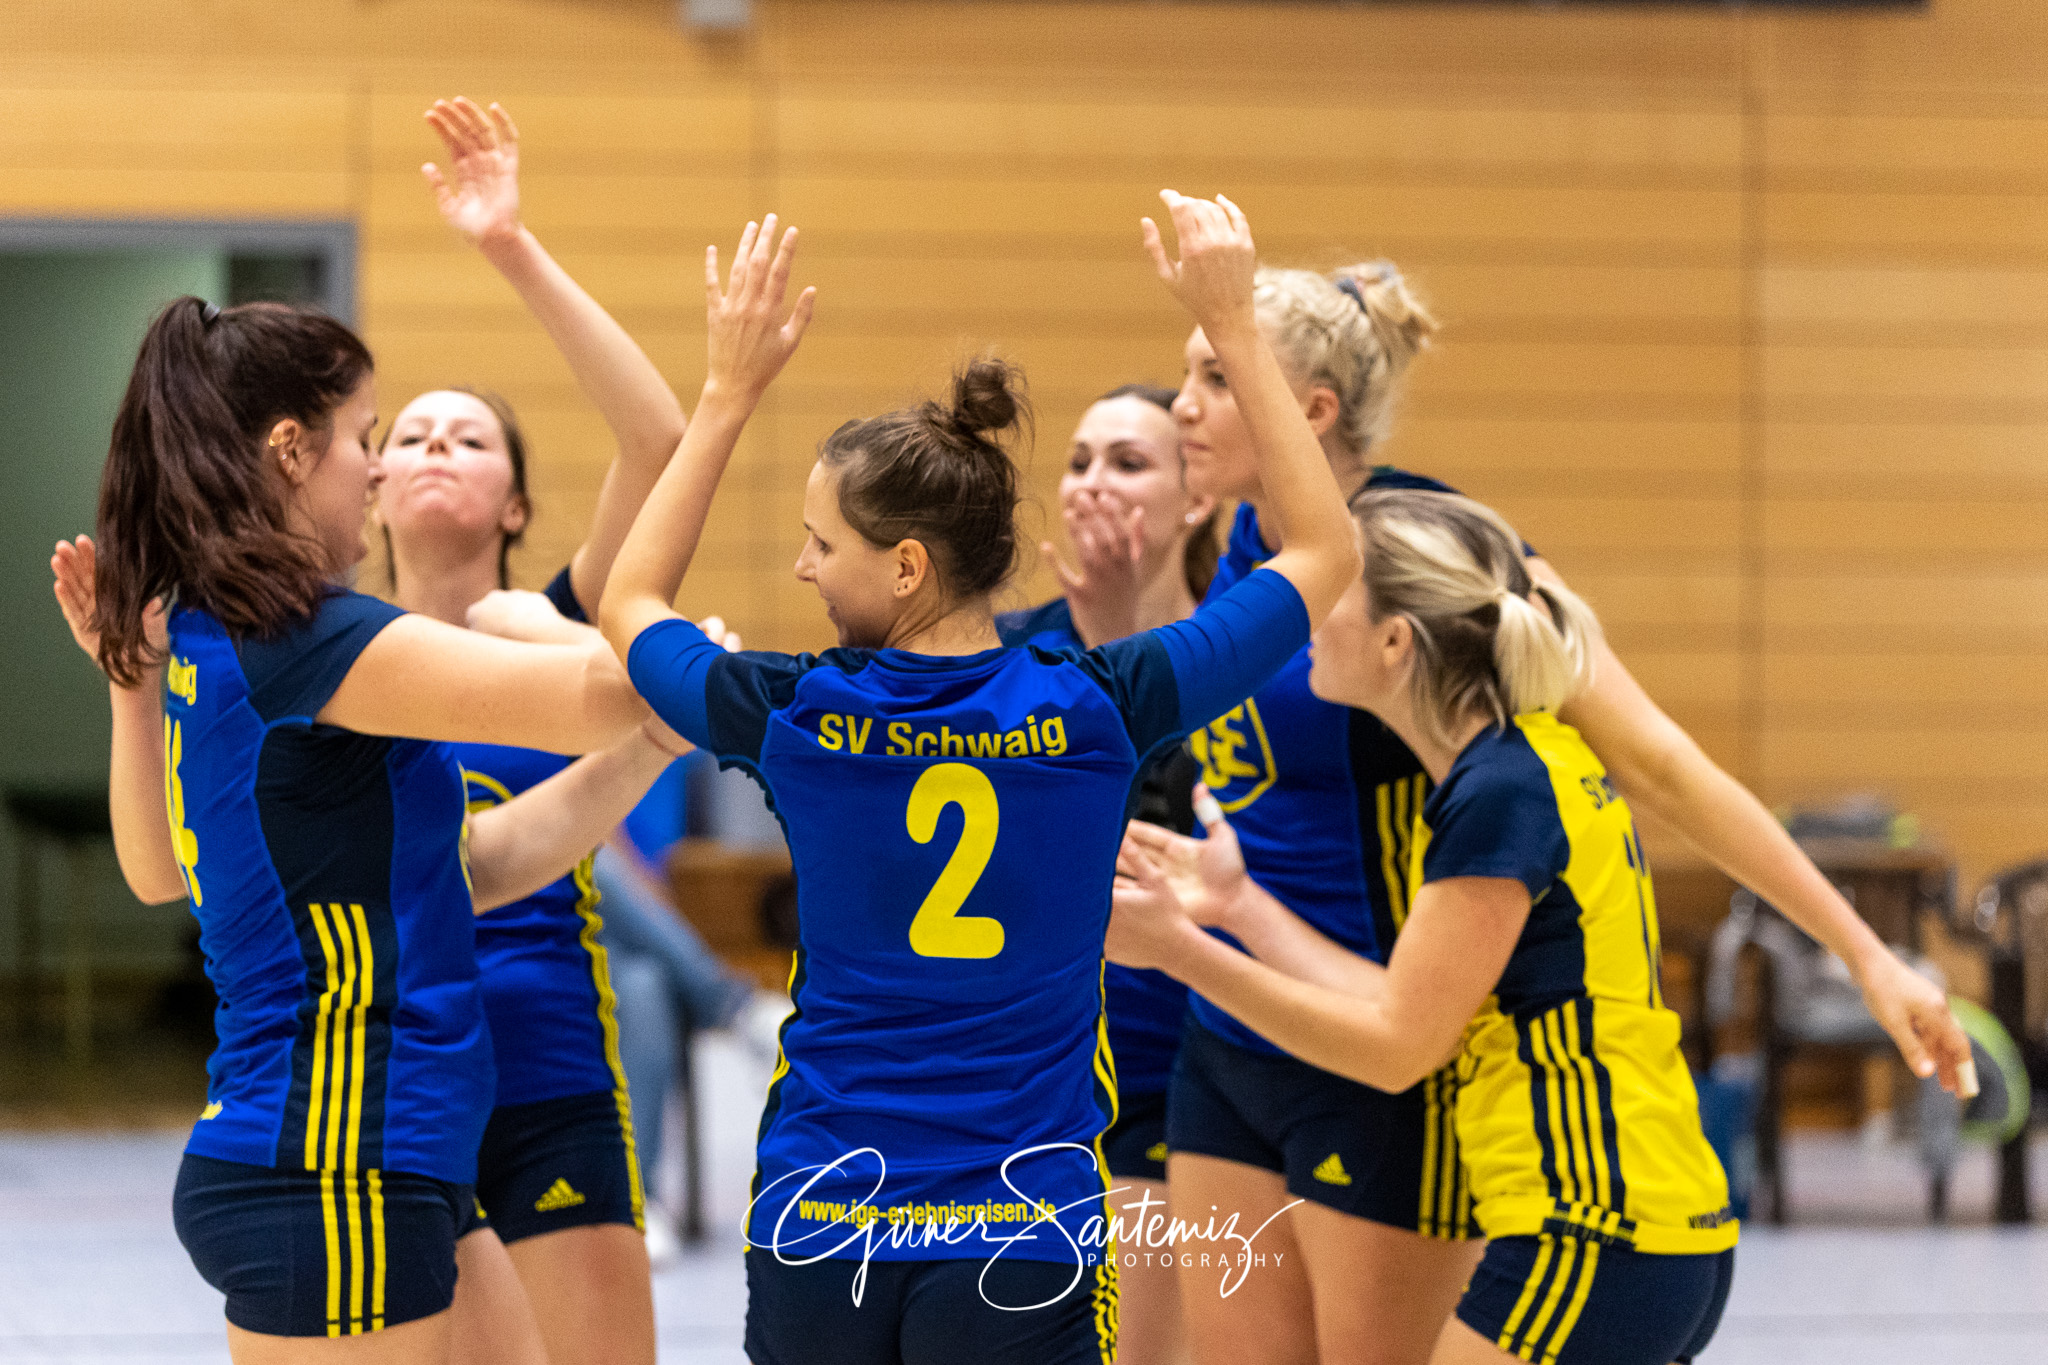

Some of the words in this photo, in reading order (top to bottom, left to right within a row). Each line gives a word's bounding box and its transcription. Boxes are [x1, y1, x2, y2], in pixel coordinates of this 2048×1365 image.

[818, 703, 873, 754] SV
[886, 705, 1068, 757] Schwaig
[906, 762, 1005, 959] 2
[799, 1197, 1056, 1229] www.ige-erlebnisreisen.de
